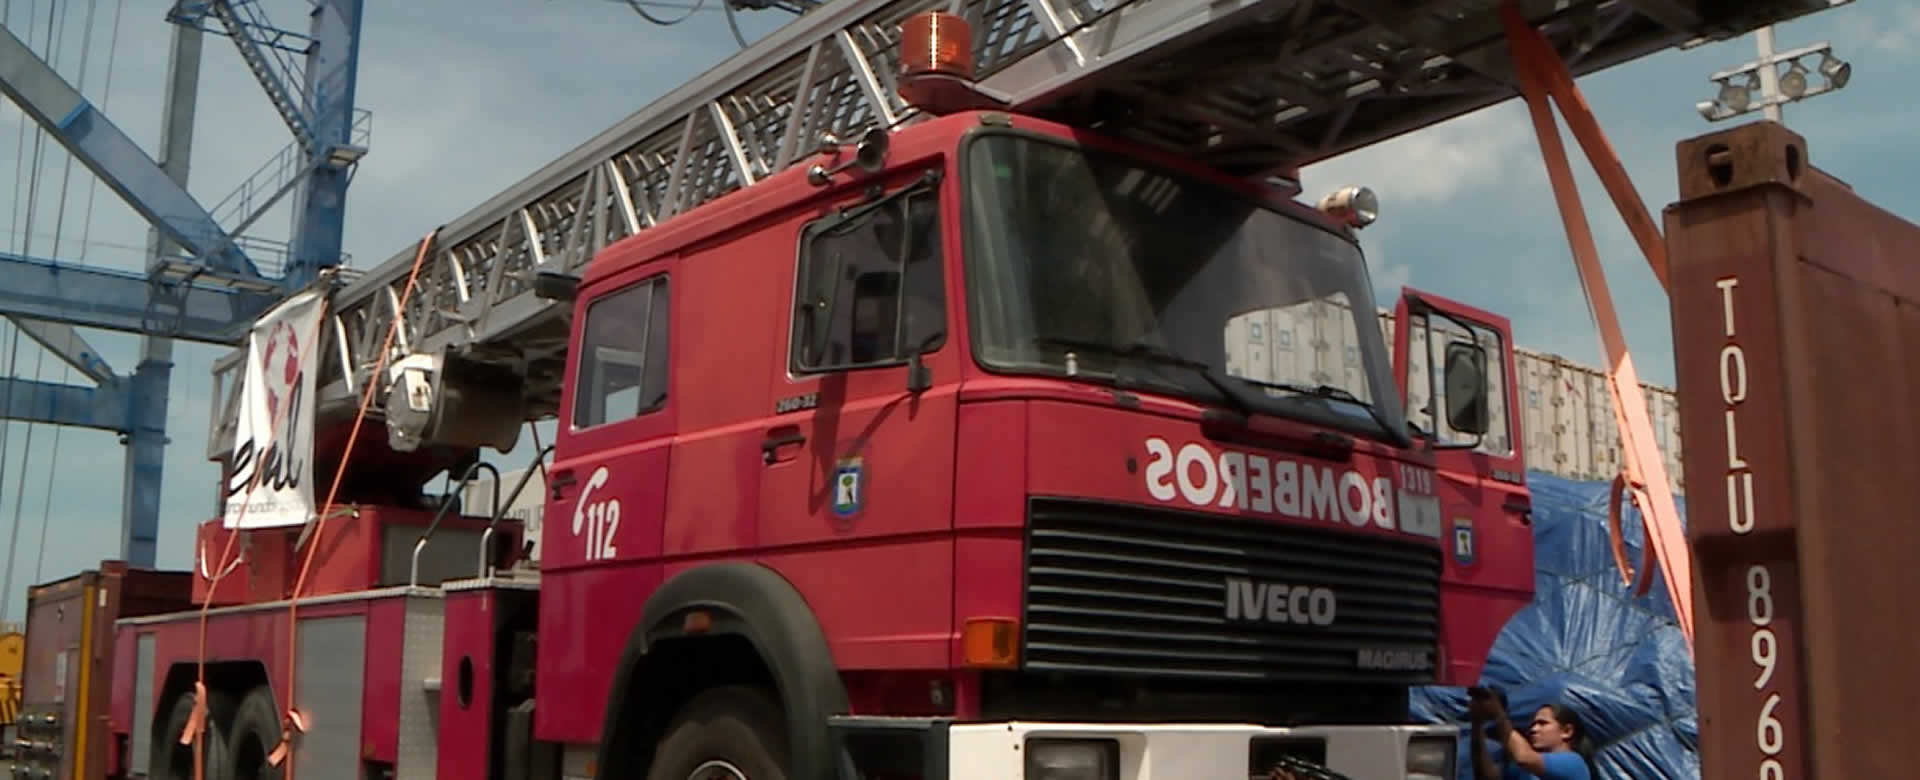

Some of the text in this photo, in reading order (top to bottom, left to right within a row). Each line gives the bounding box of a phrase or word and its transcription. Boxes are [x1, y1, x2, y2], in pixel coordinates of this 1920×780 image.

[1716, 278, 1755, 535] TOLU
[586, 499, 620, 560] 112
[1225, 577, 1336, 626] IVECO
